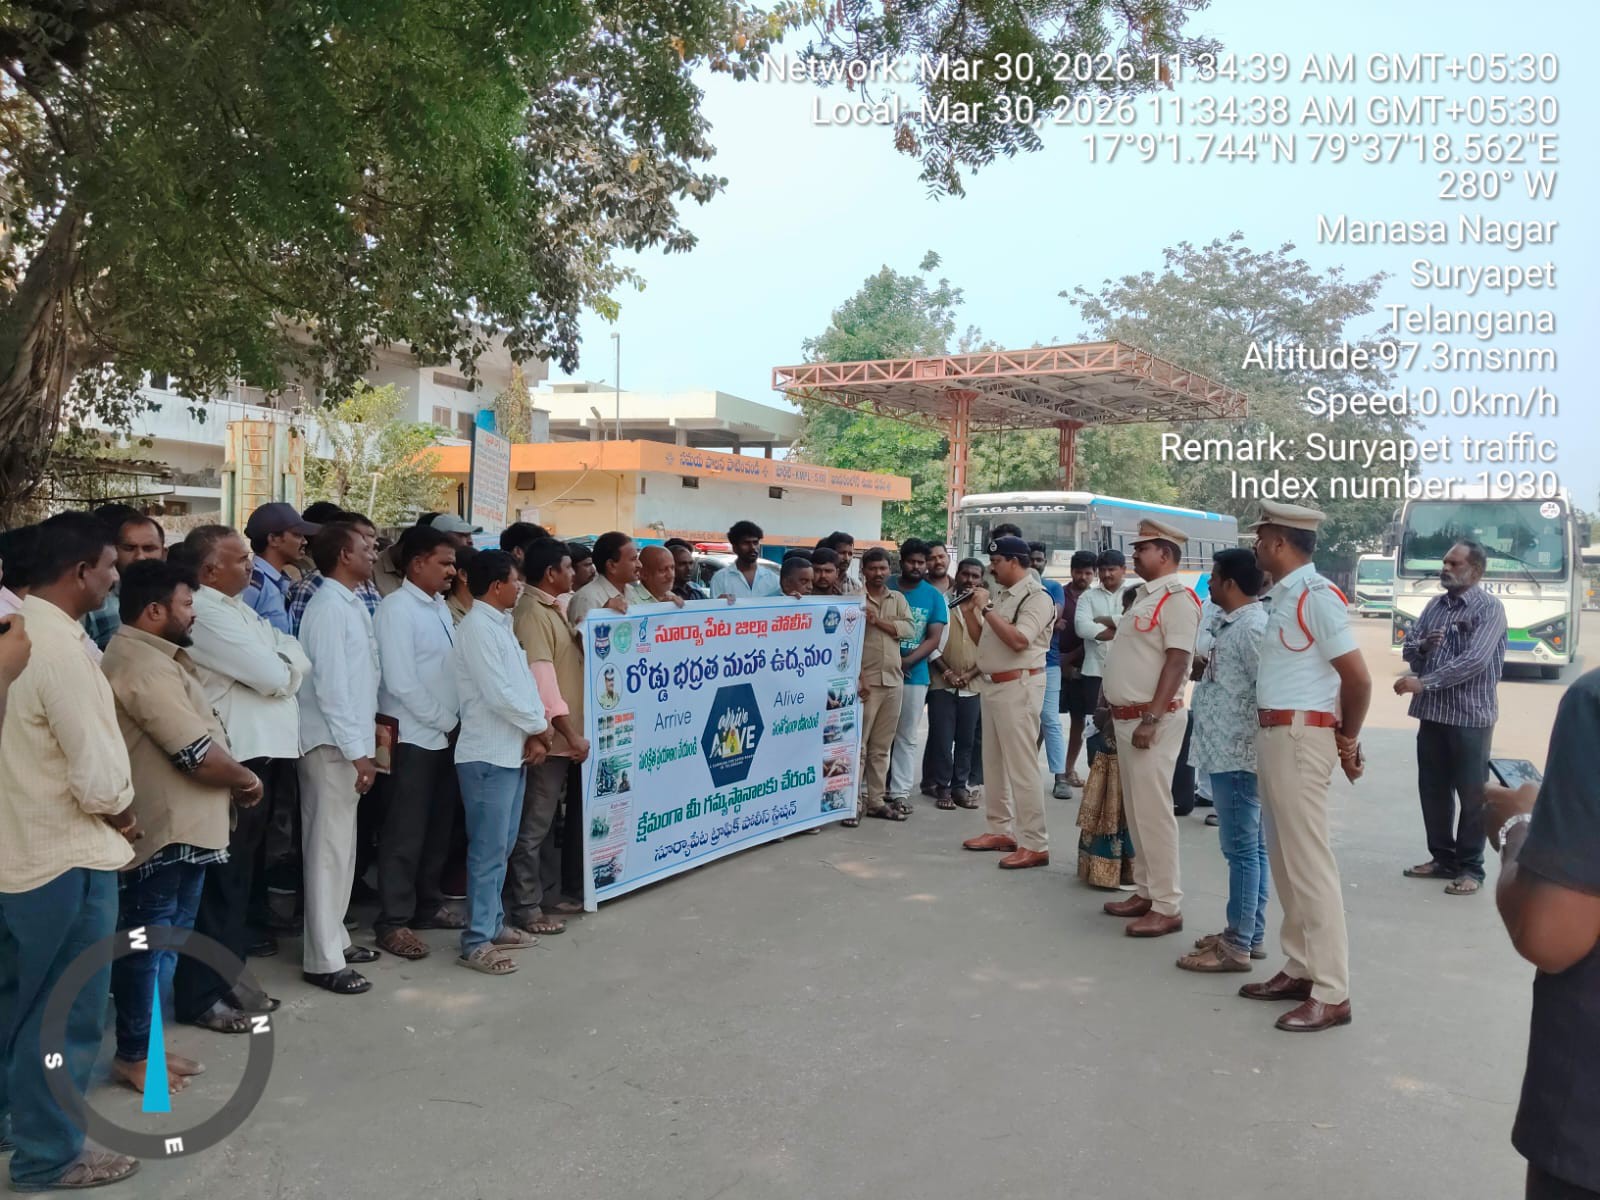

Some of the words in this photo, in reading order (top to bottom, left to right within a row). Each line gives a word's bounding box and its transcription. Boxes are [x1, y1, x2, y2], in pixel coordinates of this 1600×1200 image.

[735, 619, 768, 638] జిల్లా
[771, 612, 813, 633] పోలీస్
[626, 657, 670, 702] రోడ్డు
[673, 654, 719, 691] భద్రత
[723, 649, 766, 678] మహా
[770, 643, 833, 678] ఉద్యమం
[773, 690, 805, 708] Alive
[654, 709, 692, 732] Arrive
[636, 808, 683, 842] క్షేమంగా
[686, 798, 701, 819] మీ
[781, 766, 816, 790] చేరండి
[741, 808, 770, 831] పోలీస్
